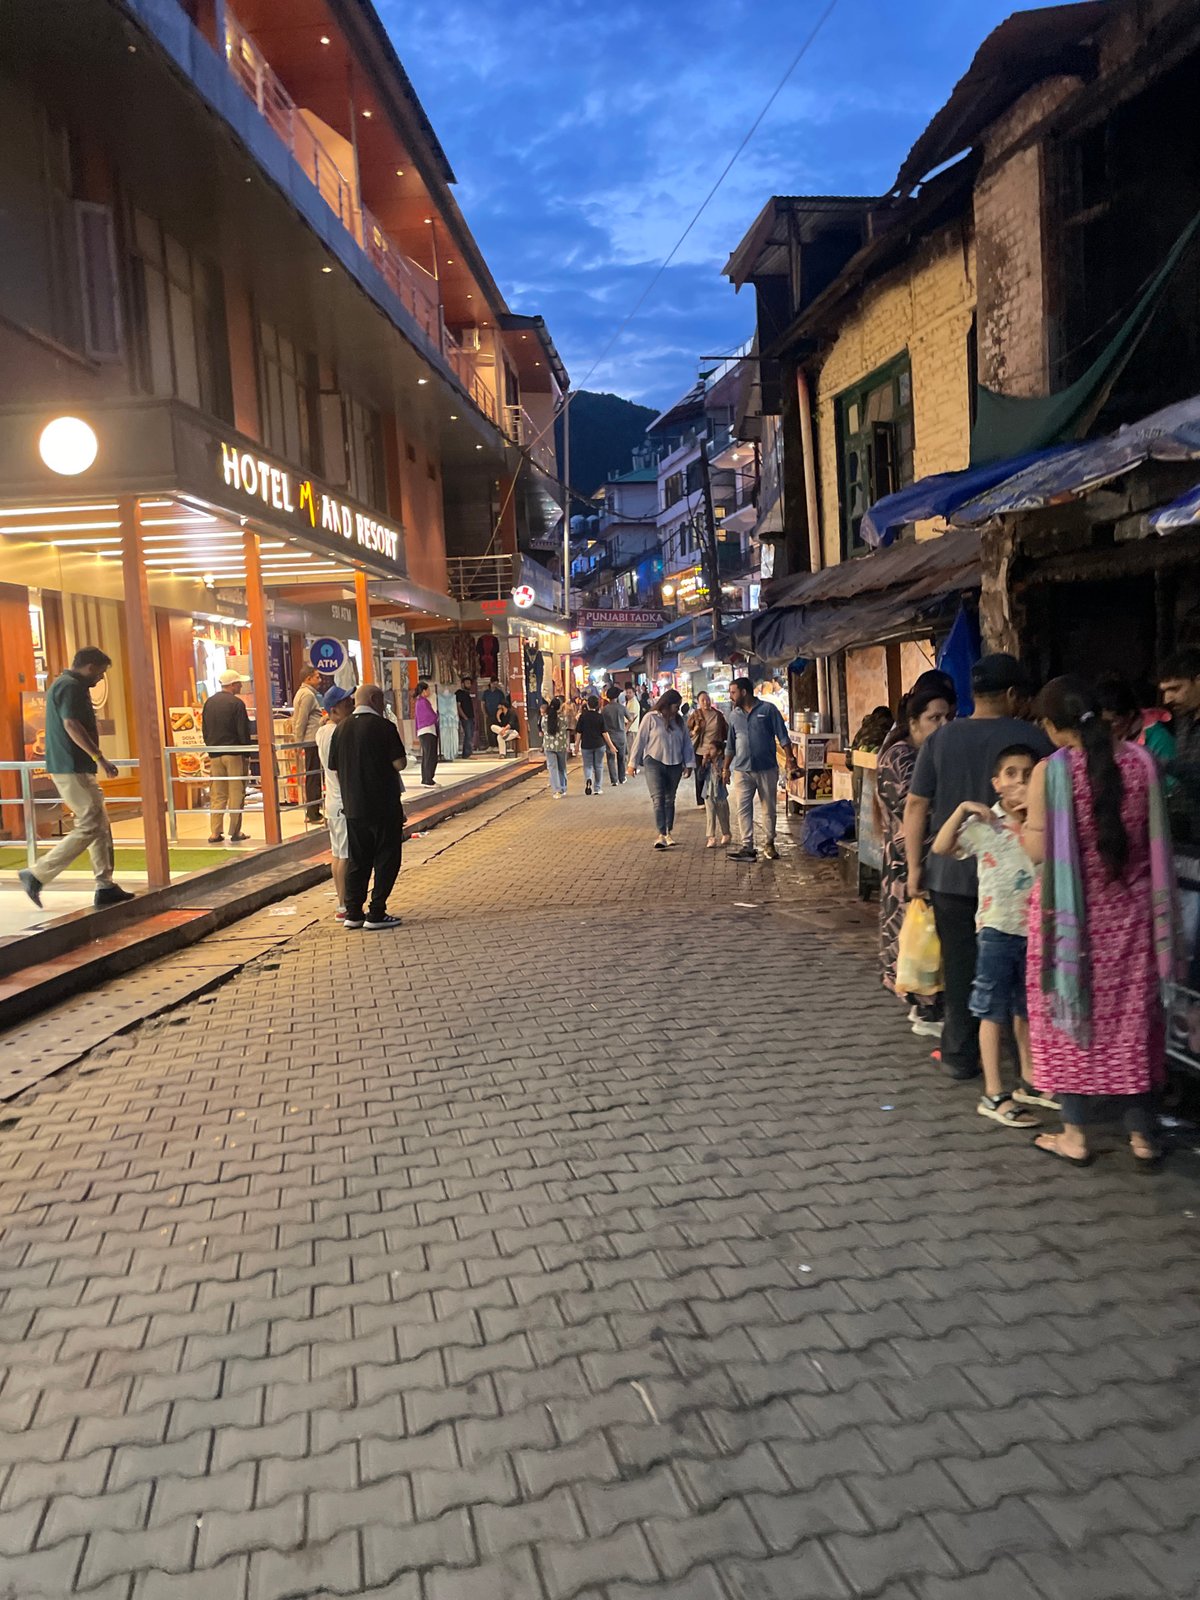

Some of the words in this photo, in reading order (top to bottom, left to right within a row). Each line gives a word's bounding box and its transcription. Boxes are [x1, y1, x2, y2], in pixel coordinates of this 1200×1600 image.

[221, 441, 294, 513] HOTEL
[321, 494, 353, 539] AND
[355, 513, 398, 561] RESORT
[331, 604, 340, 619] SBI
[340, 606, 352, 622] ATM
[586, 612, 628, 622] PUNJABI
[629, 613, 664, 622] TADKA
[316, 658, 338, 668] ATM
